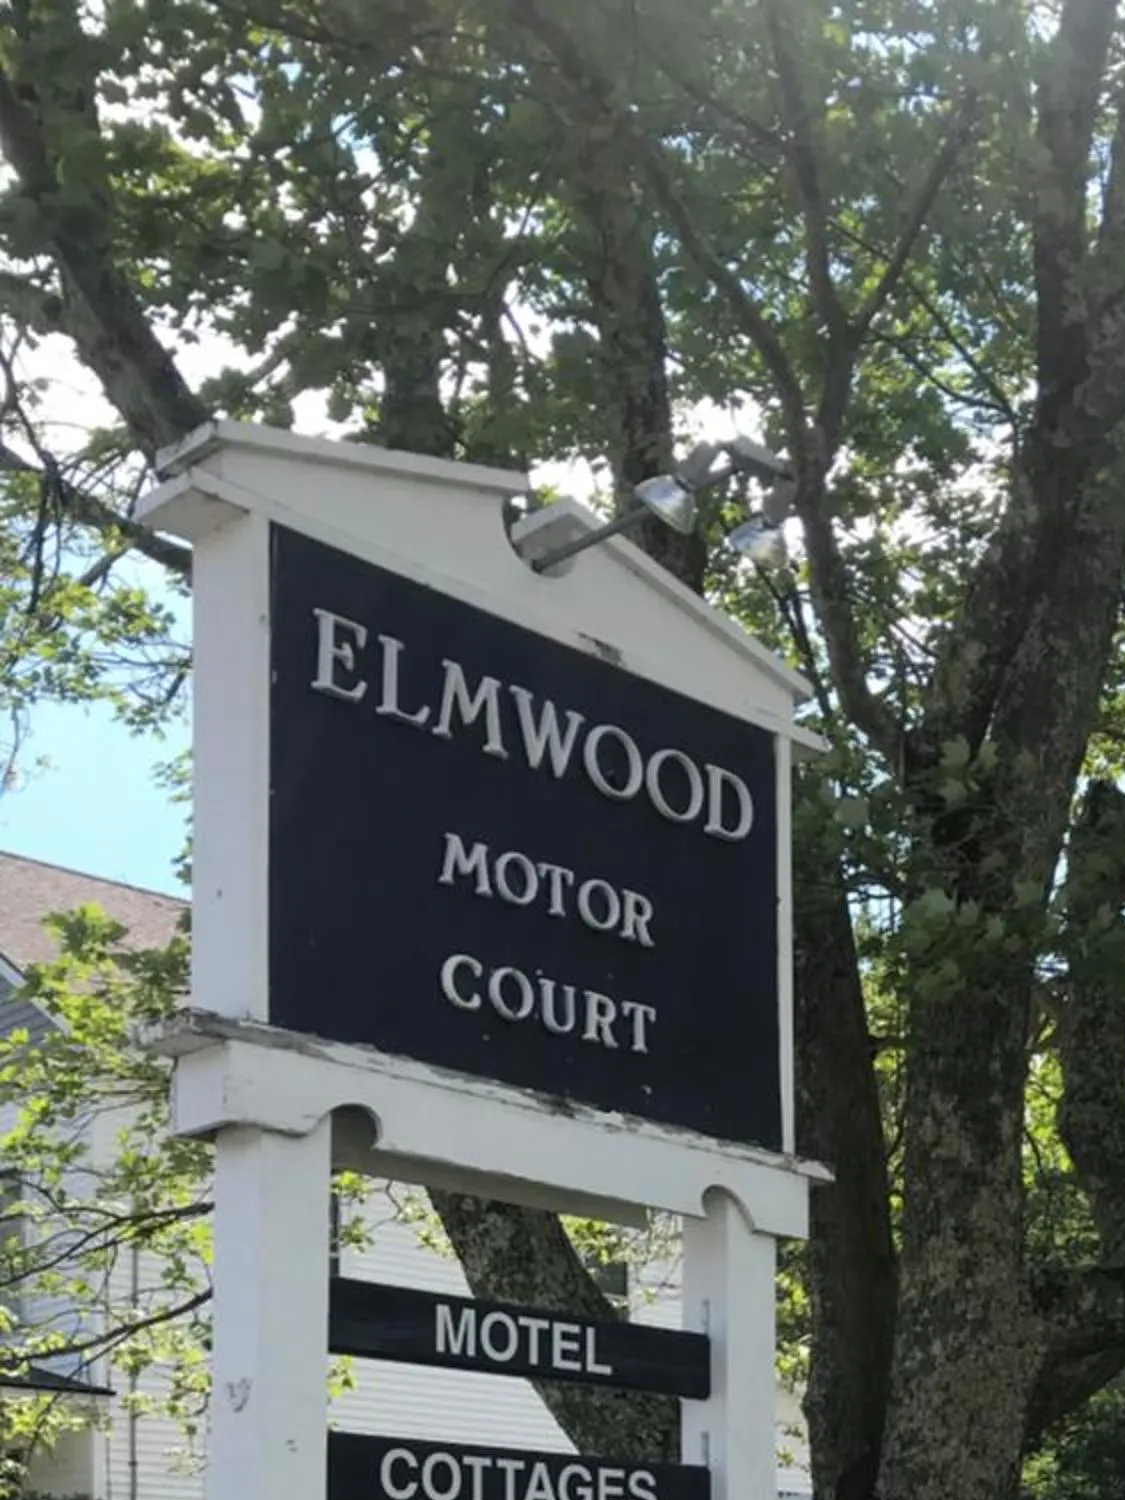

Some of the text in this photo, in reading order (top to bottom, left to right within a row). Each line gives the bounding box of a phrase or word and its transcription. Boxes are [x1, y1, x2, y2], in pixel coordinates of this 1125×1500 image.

[310, 607, 754, 841] ELMWOOD
[438, 833, 655, 947] MOTOR
[440, 954, 656, 1053] COURT
[434, 1303, 614, 1376] MOTEL
